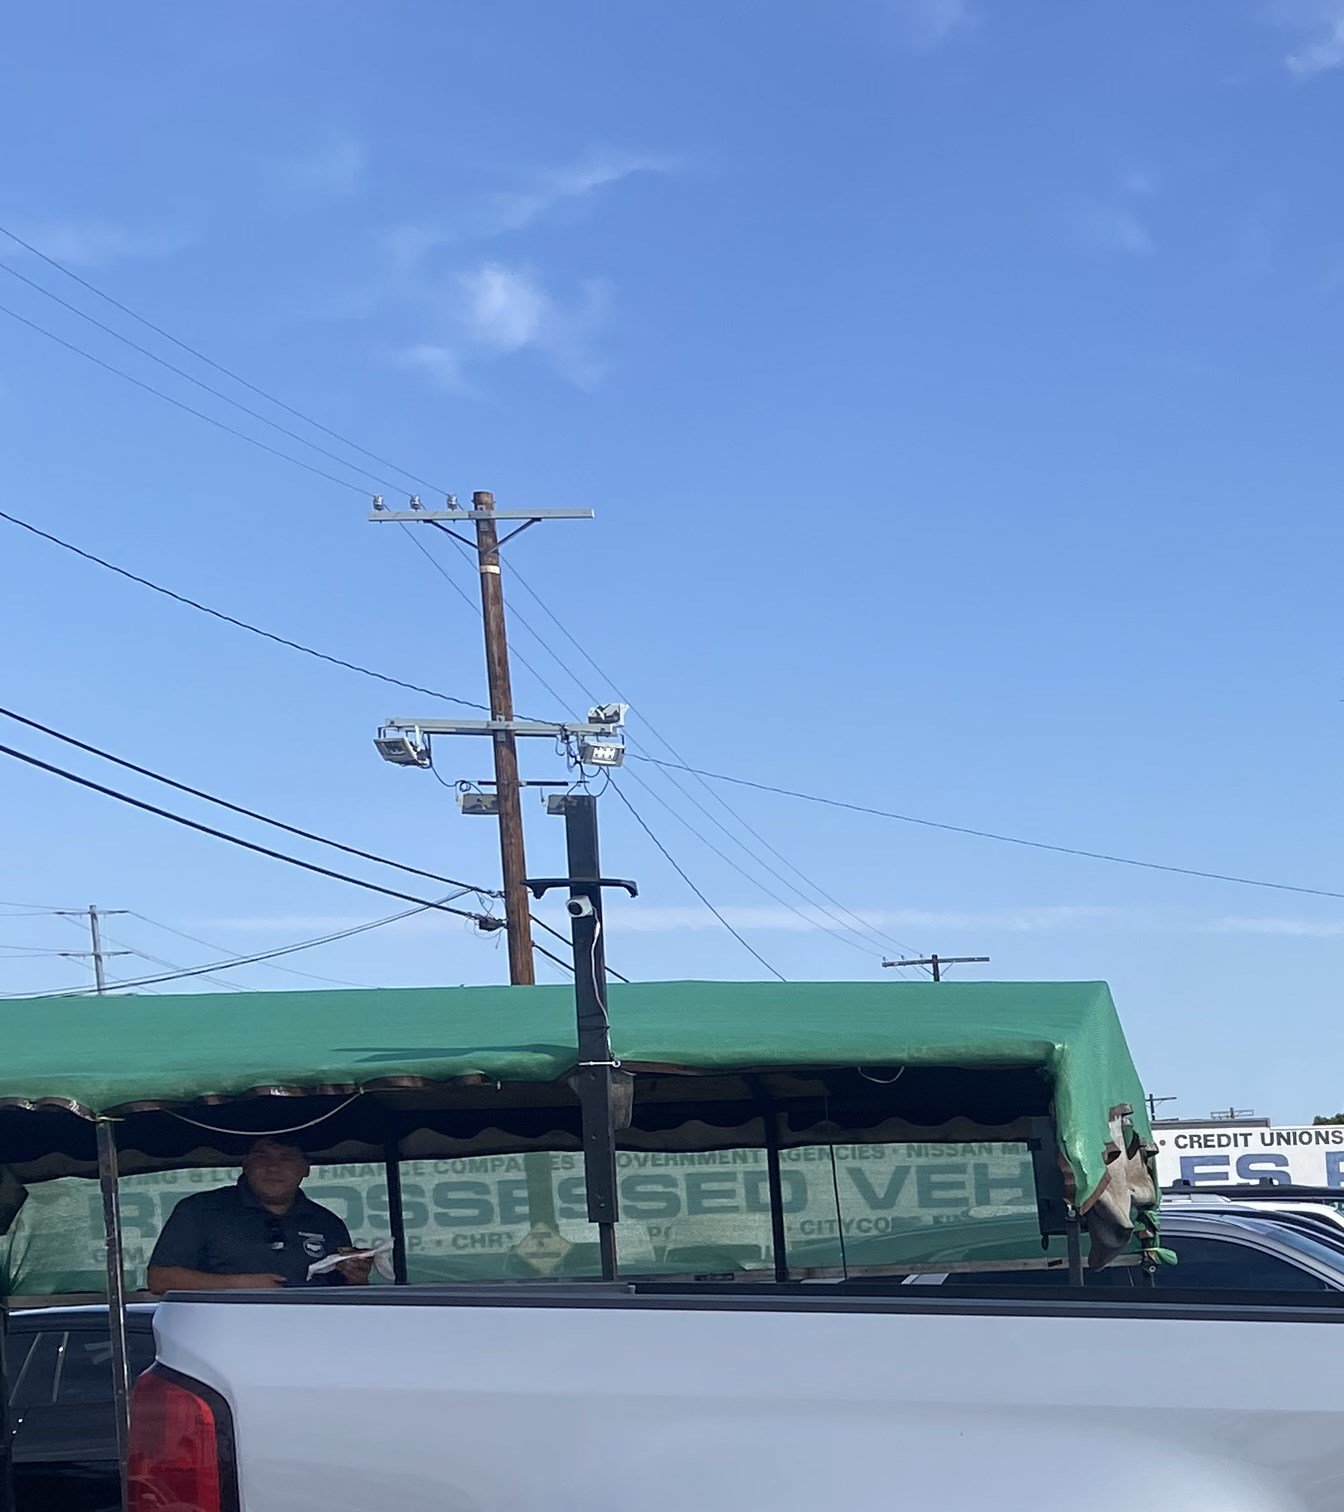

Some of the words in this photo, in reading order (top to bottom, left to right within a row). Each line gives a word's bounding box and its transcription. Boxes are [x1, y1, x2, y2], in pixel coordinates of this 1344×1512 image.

[1174, 1132, 1252, 1149] CREDIT
[1260, 1130, 1344, 1147] UNIONS
[617, 1149, 762, 1168] OVERNMENT
[906, 1141, 993, 1158] NISSAN
